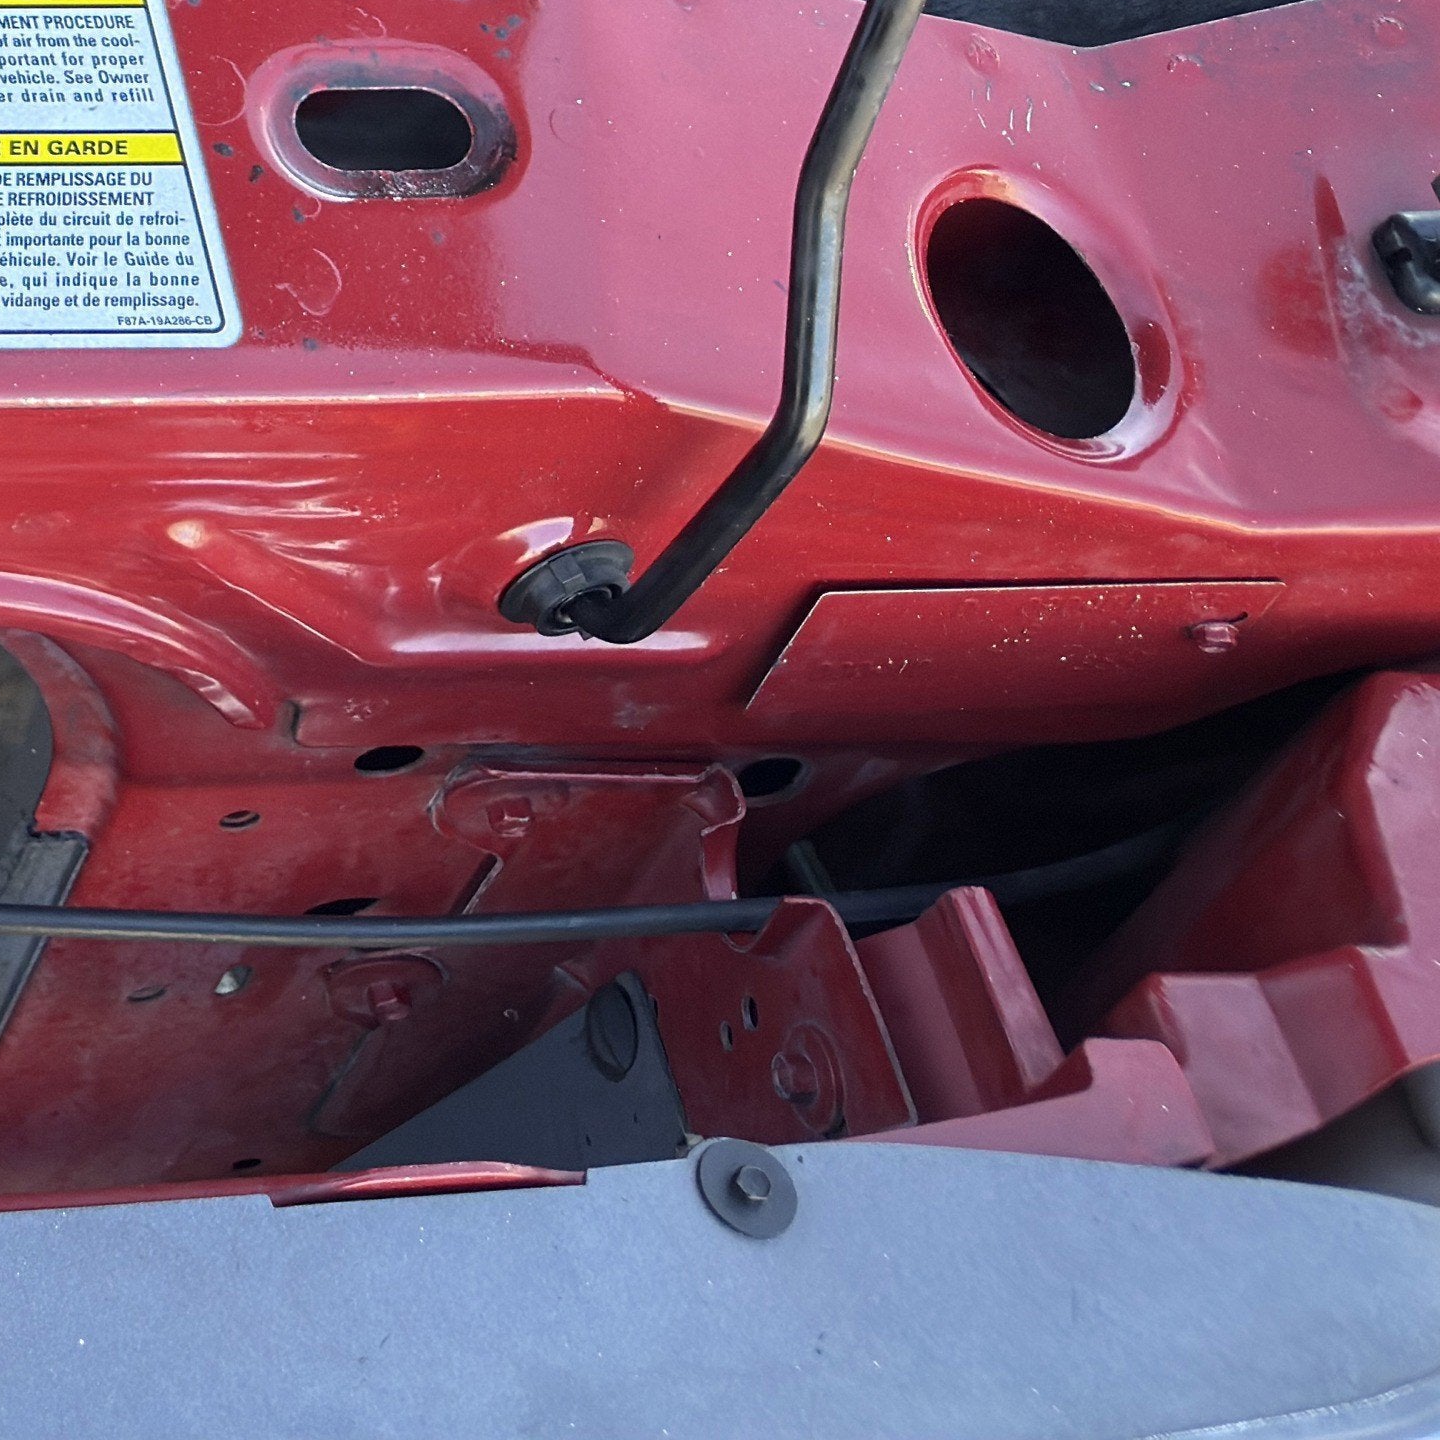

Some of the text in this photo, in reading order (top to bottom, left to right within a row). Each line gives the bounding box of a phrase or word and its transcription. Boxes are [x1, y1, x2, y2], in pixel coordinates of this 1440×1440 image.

[42, 15, 134, 29] PROCEDURE
[9, 139, 38, 155] EN
[47, 139, 127, 155] GARDE
